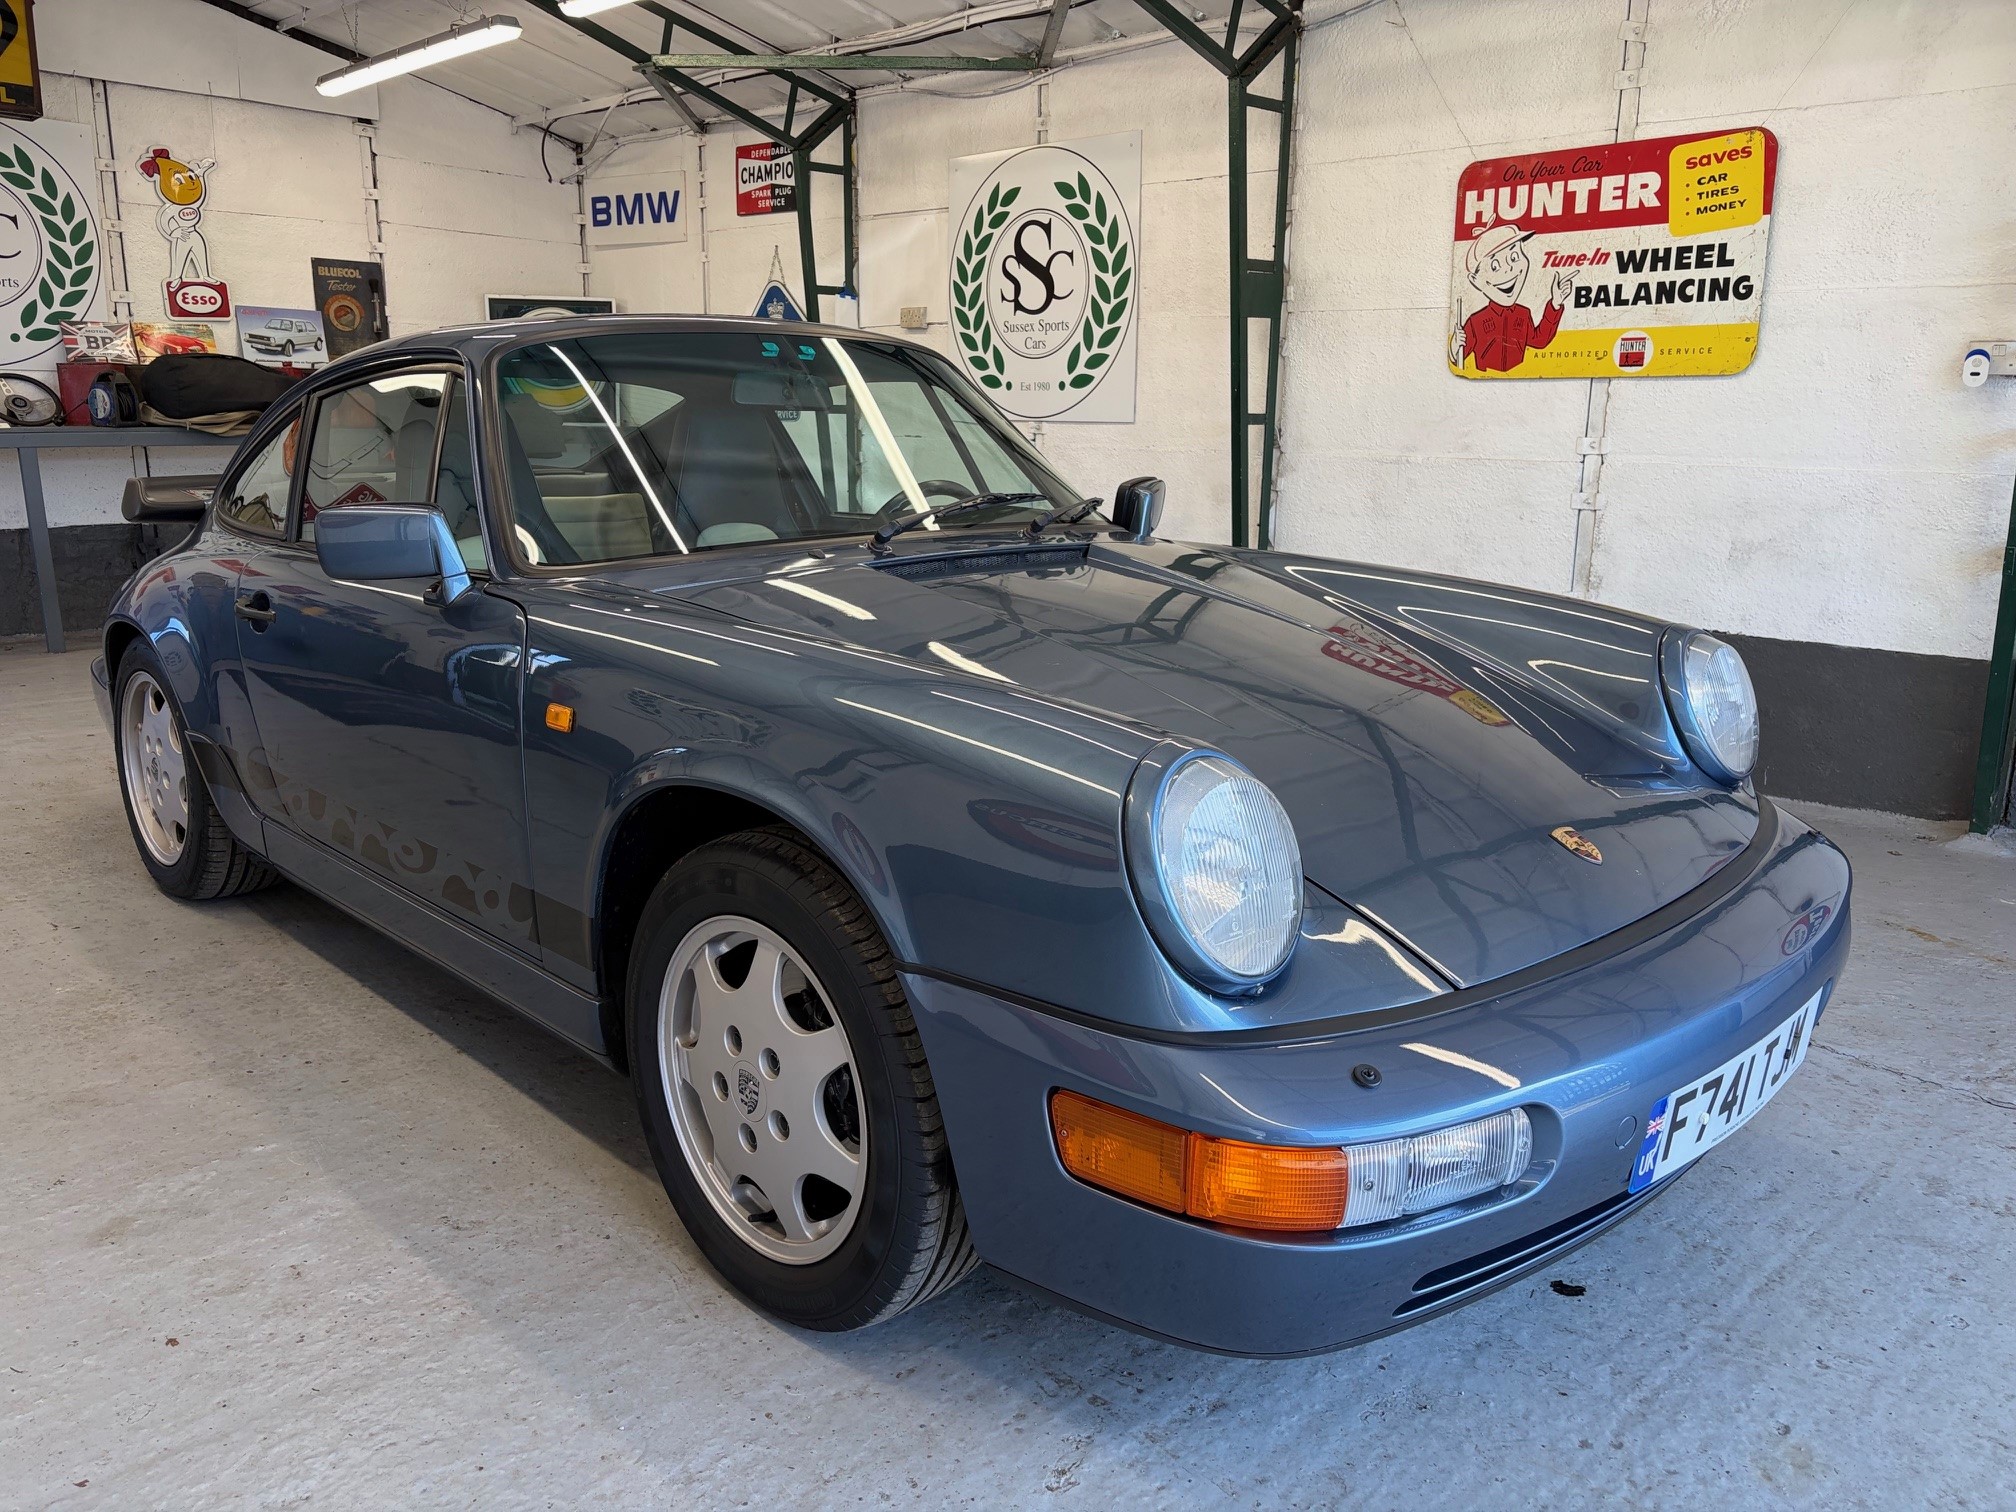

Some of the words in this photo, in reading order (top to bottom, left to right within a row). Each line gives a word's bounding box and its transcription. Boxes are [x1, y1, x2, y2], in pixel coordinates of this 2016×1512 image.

[1685, 145, 1753, 170] saves
[741, 161, 794, 184] CHAMPIO
[1503, 164, 1525, 182] On
[1529, 161, 1565, 182] Your
[1571, 155, 1603, 173] Car
[1697, 173, 1728, 185] CAR
[751, 189, 772, 198] SPARK
[775, 187, 792, 196] PLUG
[1463, 171, 1662, 225] HUNTER
[1697, 185, 1739, 200] TIRES
[591, 190, 680, 227] BMW
[758, 198, 786, 208] SERVICE
[1696, 199, 1747, 215] MONEY
[1541, 247, 1611, 268] Tune-In
[1615, 242, 1735, 274] WHEEL
[318, 266, 362, 279] BLUECOL
[0, 278, 20, 288] rts
[327, 280, 356, 291] Tester
[181, 292, 217, 305] Esso
[1574, 275, 1754, 309] BALANCING
[1003, 320, 1035, 333] Sussex
[1038, 318, 1070, 335] Sports
[1024, 337, 1047, 349] Cars
[1533, 350, 1608, 359] AUTHORIZED
[1619, 341, 1647, 352] HUNTER
[1659, 346, 1713, 356] SERVICE
[1020, 382, 1032, 391] Est
[1033, 381, 1051, 391] 1980
[775, 410, 799, 419] RVICE
